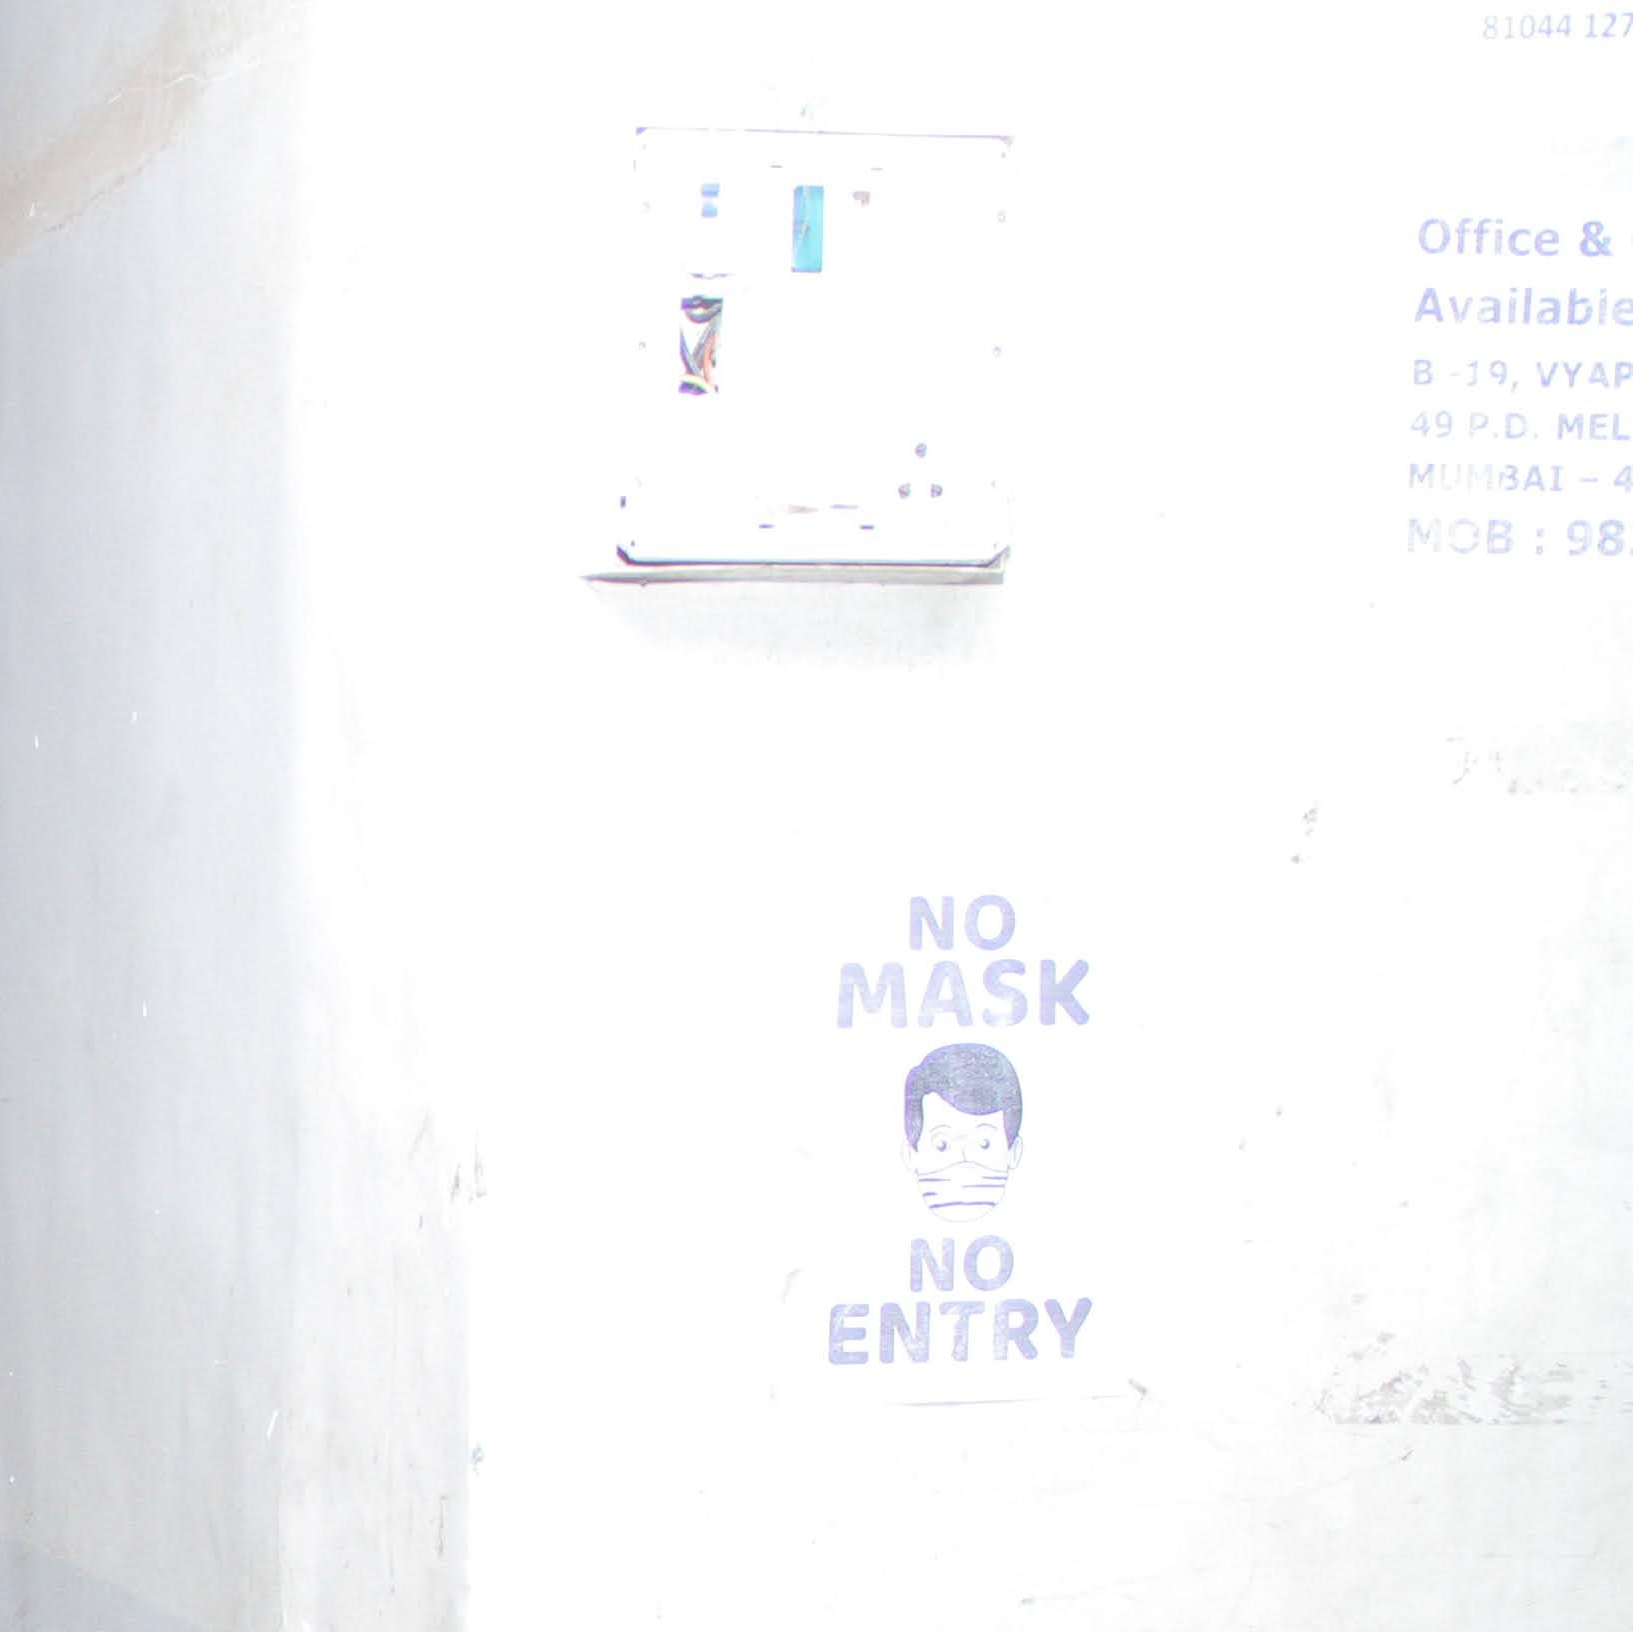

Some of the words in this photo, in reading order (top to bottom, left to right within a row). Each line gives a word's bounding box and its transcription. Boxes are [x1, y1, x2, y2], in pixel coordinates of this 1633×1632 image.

[1482, 13, 1572, 40] 81044
[1417, 217, 1560, 257] Office
[1579, 219, 1614, 257] &
[1410, 409, 1453, 439] 49
[1409, 463, 1565, 493] MUMBAI
[1407, 517, 1516, 555] MOB
[1566, 518, 1633, 557] 98
[908, 894, 1017, 952] NO
[836, 957, 1092, 1029] MASK
[908, 1233, 1016, 1293] NO
[827, 1296, 1094, 1366] ENTRY
